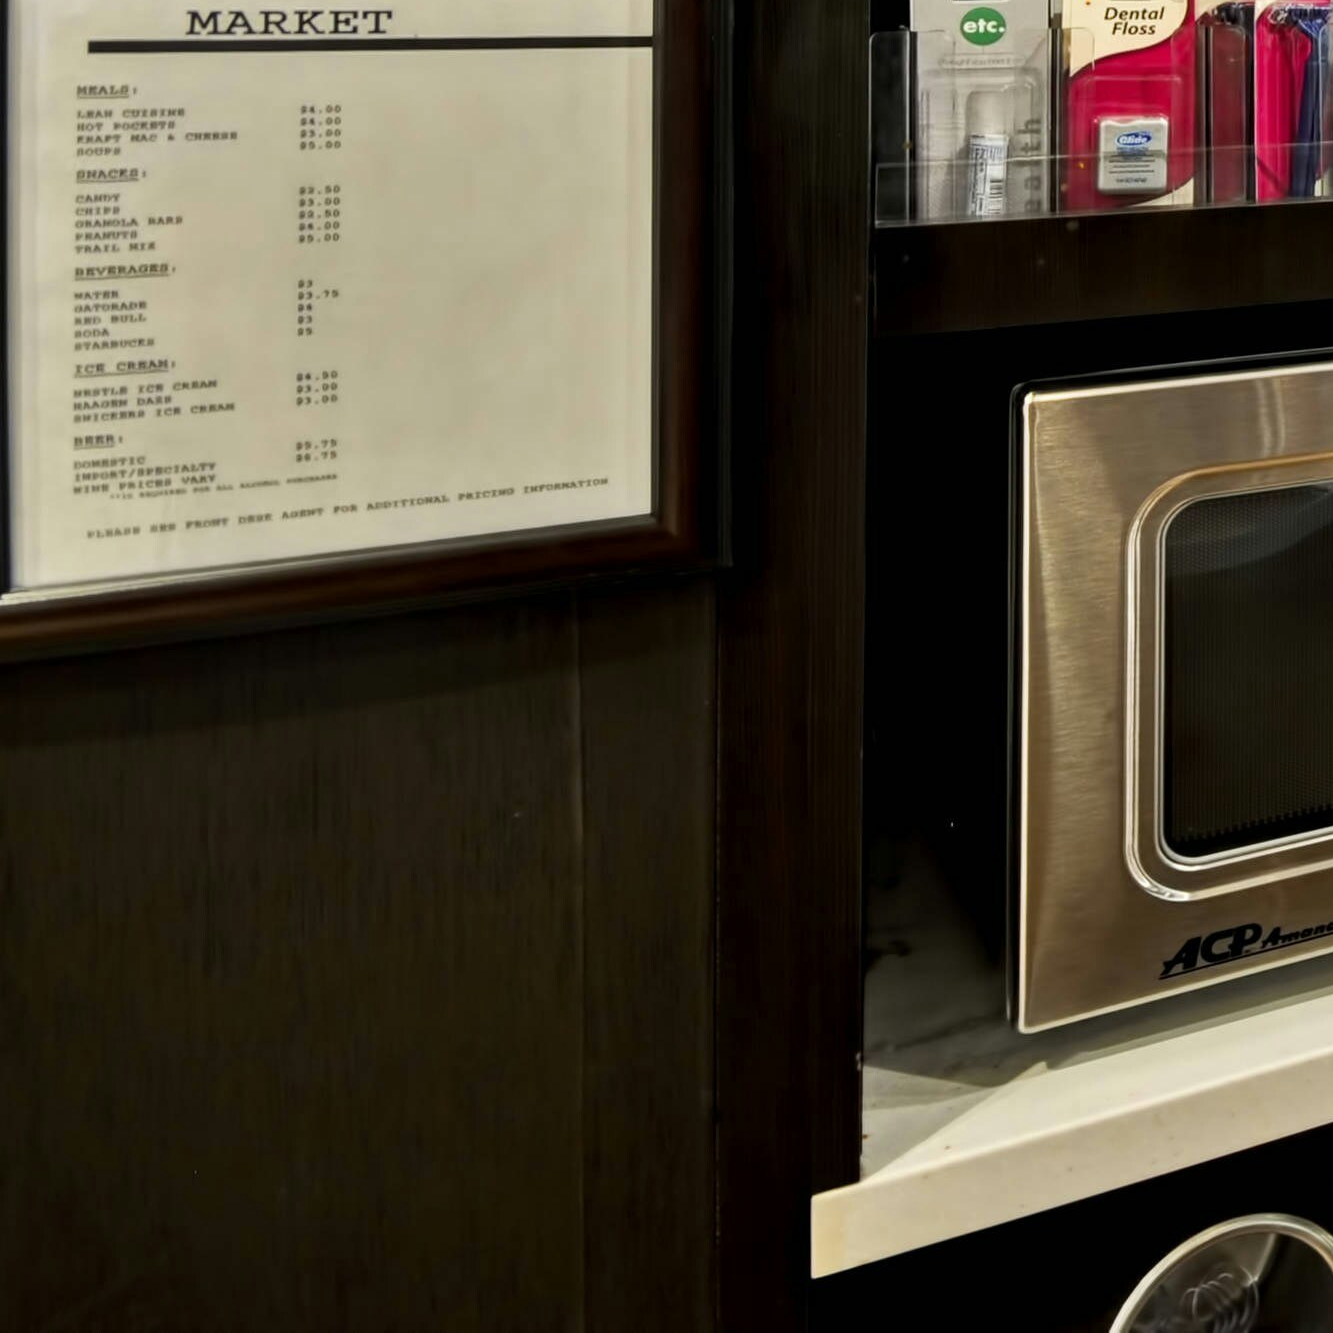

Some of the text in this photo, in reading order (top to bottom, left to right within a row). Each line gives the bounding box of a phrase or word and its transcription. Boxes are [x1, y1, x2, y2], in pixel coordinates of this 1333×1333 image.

[1104, 6, 1165, 21] Dental
[186, 9, 394, 35] MARKET
[963, 17, 1006, 34] etc.
[1111, 21, 1157, 36] Floss
[76, 84, 138, 97] MEALS:
[77, 109, 113, 120] LEAN
[122, 108, 186, 119] CUISINE
[77, 122, 104, 133] HOT
[113, 121, 176, 132] POCKETS
[77, 134, 122, 145] KRAFT
[131, 133, 158, 143] MAC
[167, 133, 175, 142] &
[185, 131, 239, 142] CHEESE
[1118, 135, 1149, 145] Glide
[77, 146, 122, 157] SOUPS
[76, 168, 147, 182] SNACKS:
[75, 194, 121, 205] CANDY
[75, 206, 121, 217] CHIPS
[75, 218, 139, 230] GRANOLA
[148, 216, 184, 227] BARS
[75, 231, 138, 242] PEANUTS
[75, 244, 121, 255] TRAIL
[129, 242, 156, 253] MIX
[75, 263, 177, 279] BEVERAGES:
[74, 290, 120, 301] WATER
[74, 300, 148, 314] GATORADE
[74, 315, 102, 326] RED
[110, 313, 147, 325] BULL
[74, 328, 110, 339] SODA
[74, 338, 155, 352] STARBUCKS
[74, 359, 176, 377] ICE CREAM:
[74, 379, 218, 399] NESTLE ICE CREAM
[74, 399, 129, 412] HAAGEN
[74, 410, 146, 424] SNICKERS
[156, 407, 182, 418] ICE
[190, 403, 236, 415] CREAM
[74, 435, 124, 449] BEER:
[74, 456, 146, 470] DOMESTIC
[73, 474, 216, 495] WINE PRICES VARY
[86, 478, 609, 539] PLEASE SEE FRONT DESK AGENT FOR ADDITIONAL PRICING INFORMATION
[1160, 923, 1263, 976] ACP
